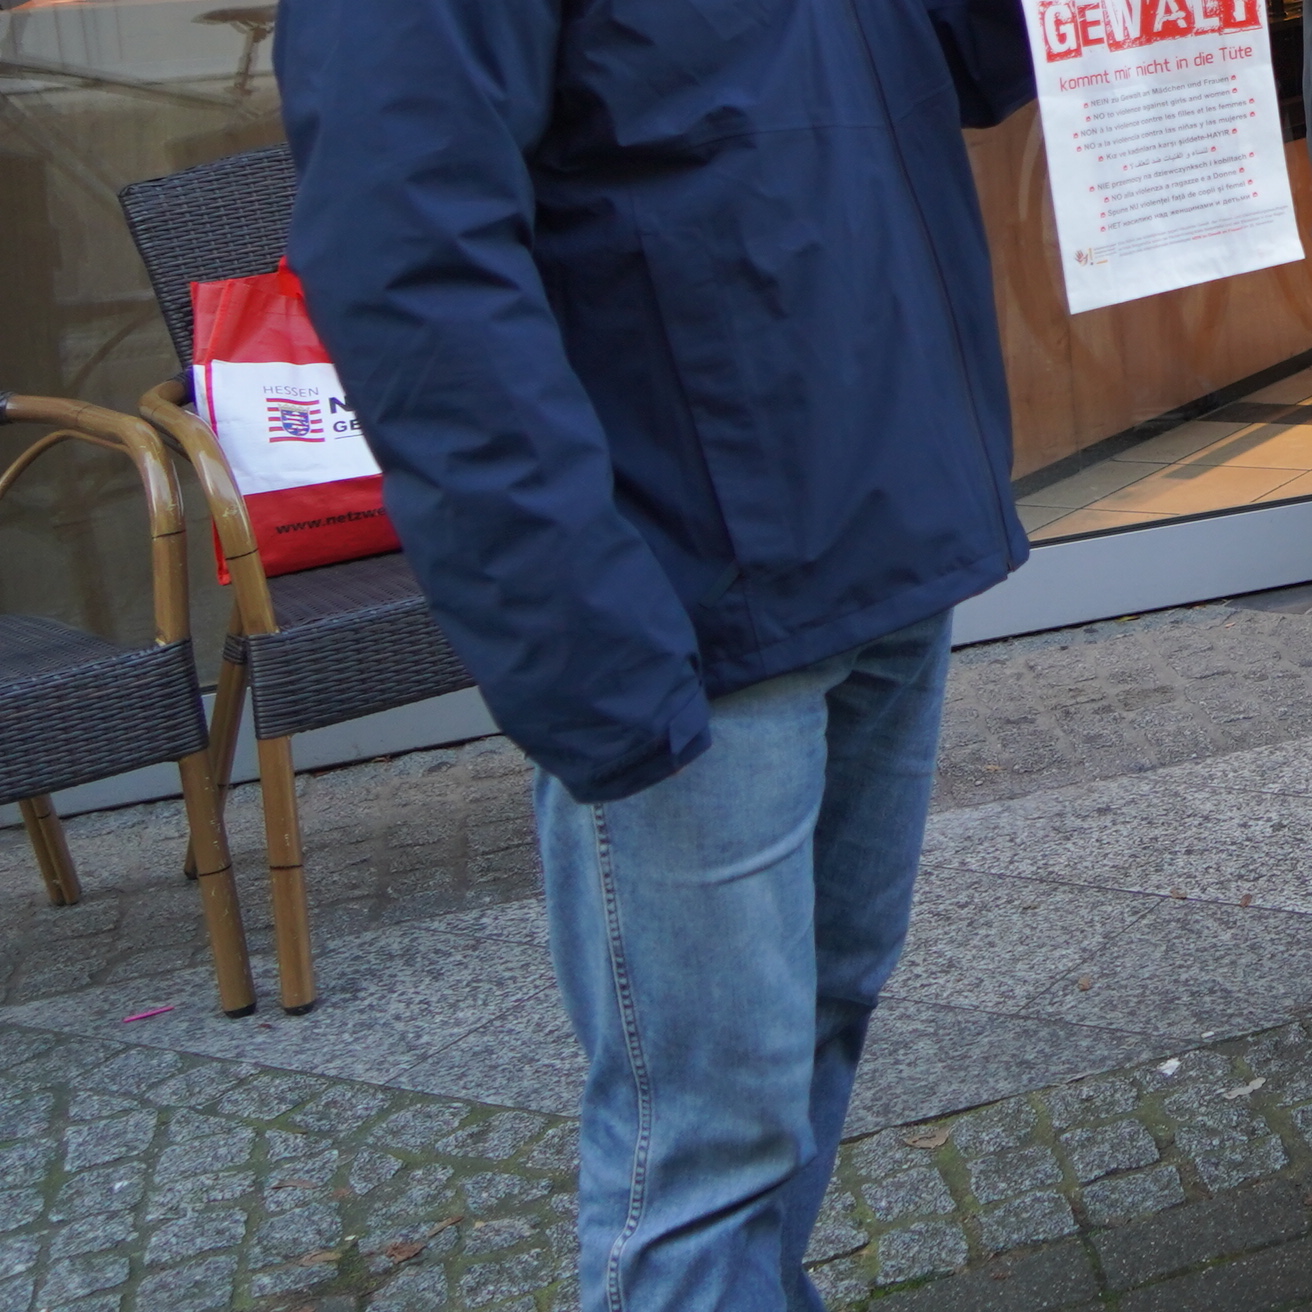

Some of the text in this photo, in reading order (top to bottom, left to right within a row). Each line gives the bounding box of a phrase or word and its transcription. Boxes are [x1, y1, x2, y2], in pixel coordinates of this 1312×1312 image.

[1058, 40, 1253, 93] kommt mir nicht in die Tüte
[1090, 97, 1109, 107] NEIN
[1119, 91, 1141, 102] Gewalt
[1151, 82, 1186, 96] Mädchen
[1186, 79, 1202, 89] und
[1203, 74, 1229, 86] Frauen
[1093, 89, 1230, 121] NO to violence against girls and women
[1079, 127, 1097, 137] NON
[1105, 124, 1113, 132] la
[1113, 119, 1140, 131] violence
[1140, 115, 1163, 125] contre
[1164, 112, 1176, 121] les
[1176, 108, 1195, 118] filles
[1196, 107, 1204, 115] et
[1205, 104, 1217, 113] les
[1217, 99, 1247, 110] femmes
[1083, 142, 1096, 150] NO
[1103, 139, 1111, 147] la
[1112, 133, 1140, 145] violencia
[1140, 130, 1163, 139] contra
[1164, 126, 1176, 135] las
[1177, 122, 1198, 132] niñas
[1205, 118, 1217, 127] las
[1218, 113, 1248, 126] mujeres
[1096, 182, 1110, 191] NIE
[1110, 175, 1142, 189] przemocy
[1111, 193, 1123, 201] NO
[1123, 190, 1134, 199] alla
[1135, 184, 1163, 196] violenza
[1171, 177, 1199, 189] ragazze
[1212, 168, 1237, 179] Donne
[1107, 206, 1129, 217] Spune
[1129, 203, 1139, 212] NU
[1187, 191, 1196, 199] de
[1107, 221, 1122, 230] НЕТ
[263, 385, 319, 398] HESSEN
